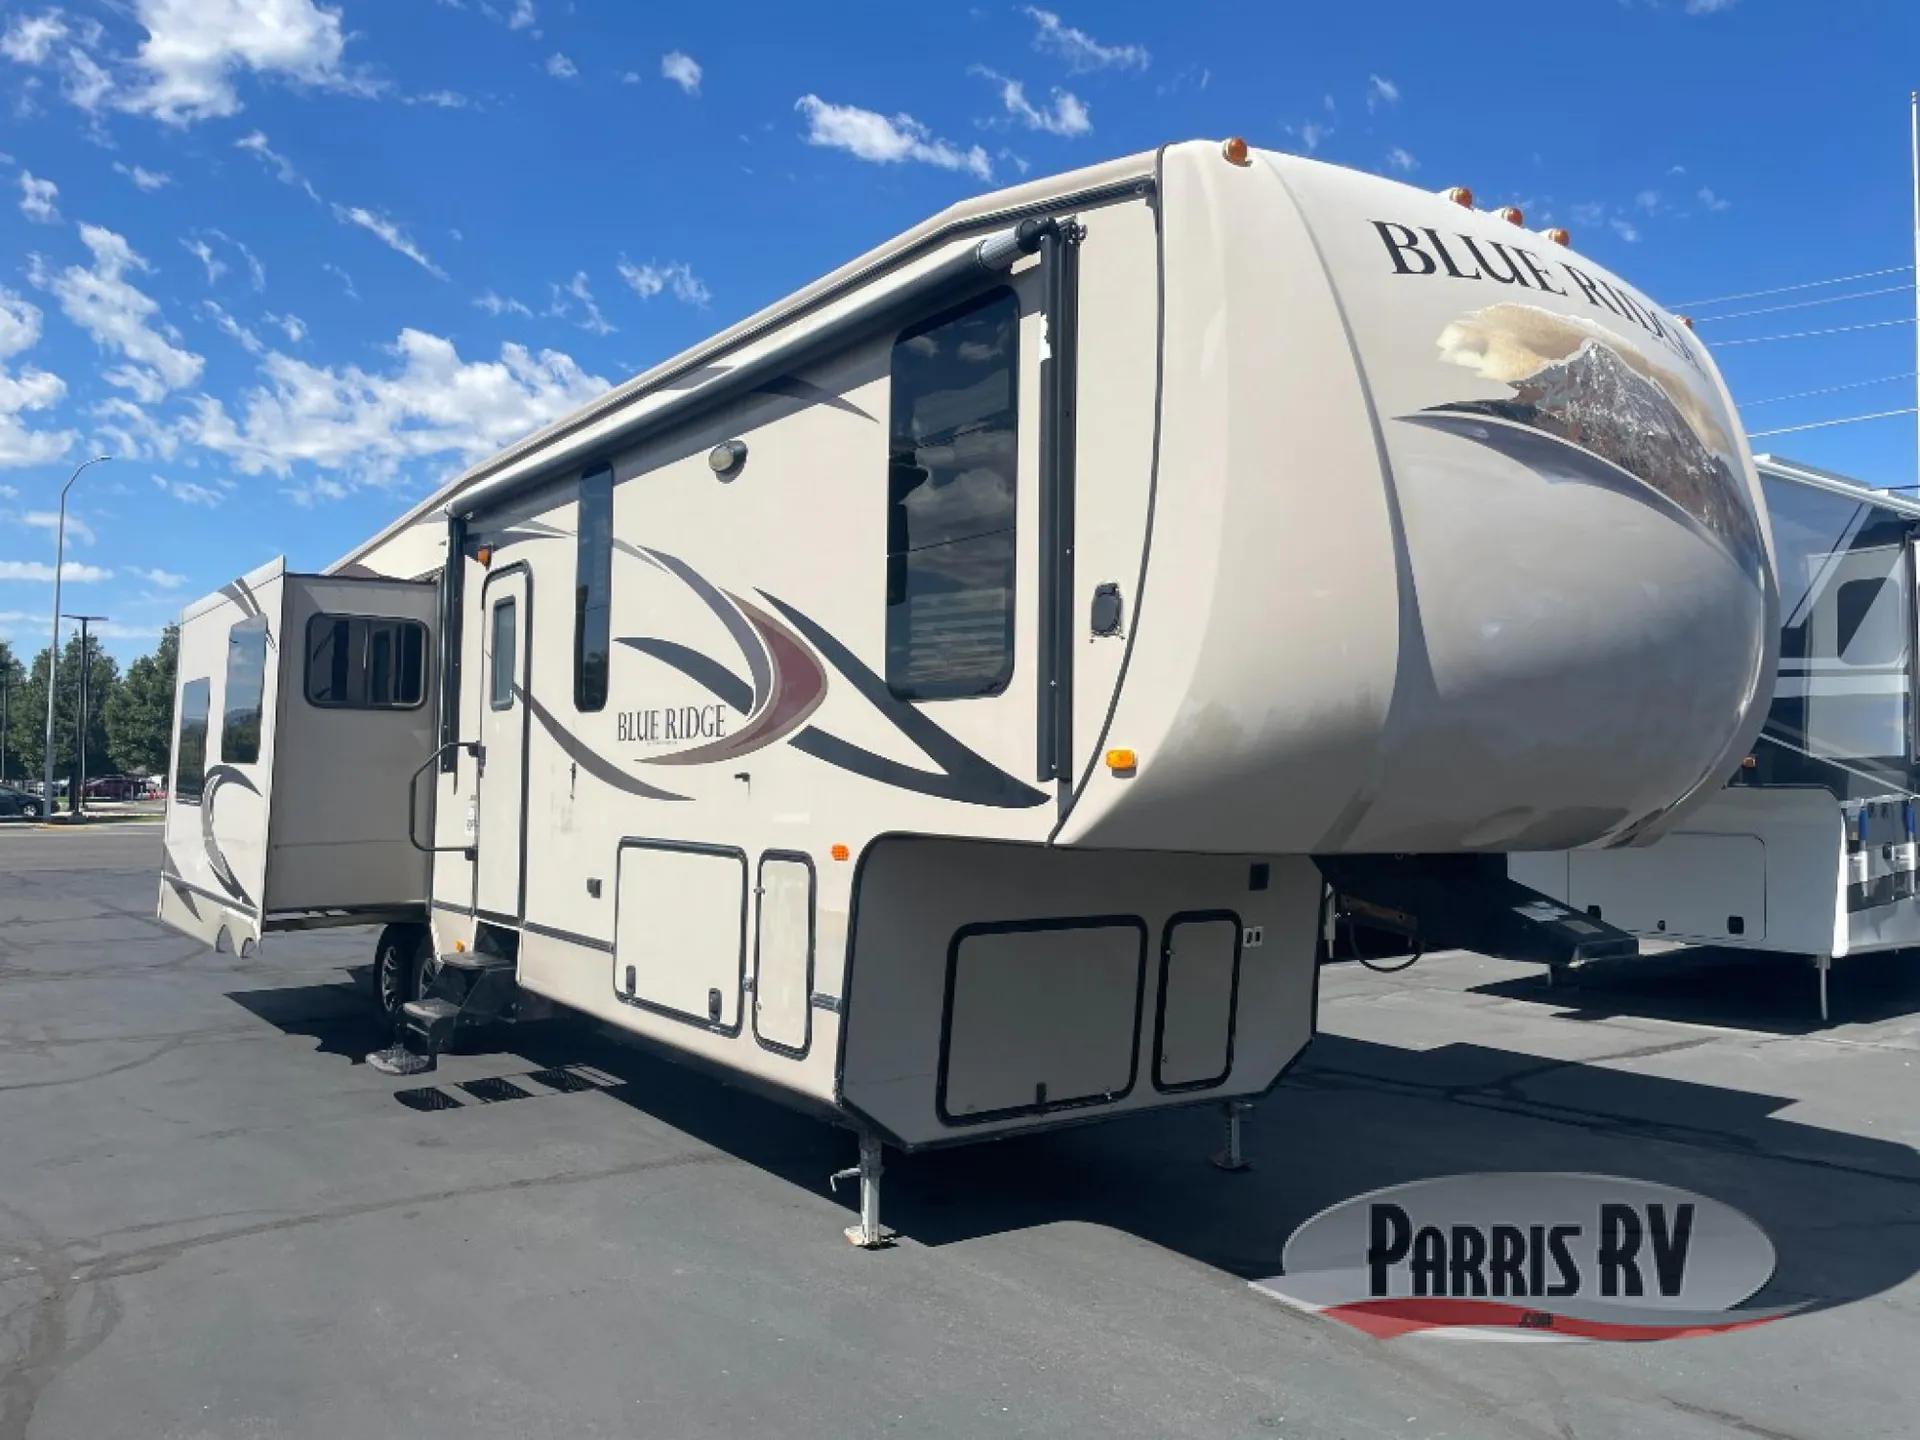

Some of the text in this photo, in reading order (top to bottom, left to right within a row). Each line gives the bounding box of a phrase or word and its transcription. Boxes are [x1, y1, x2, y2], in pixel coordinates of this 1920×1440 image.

[1367, 219, 1569, 297] BLUE
[617, 704, 727, 742] BLUE RIDGE
